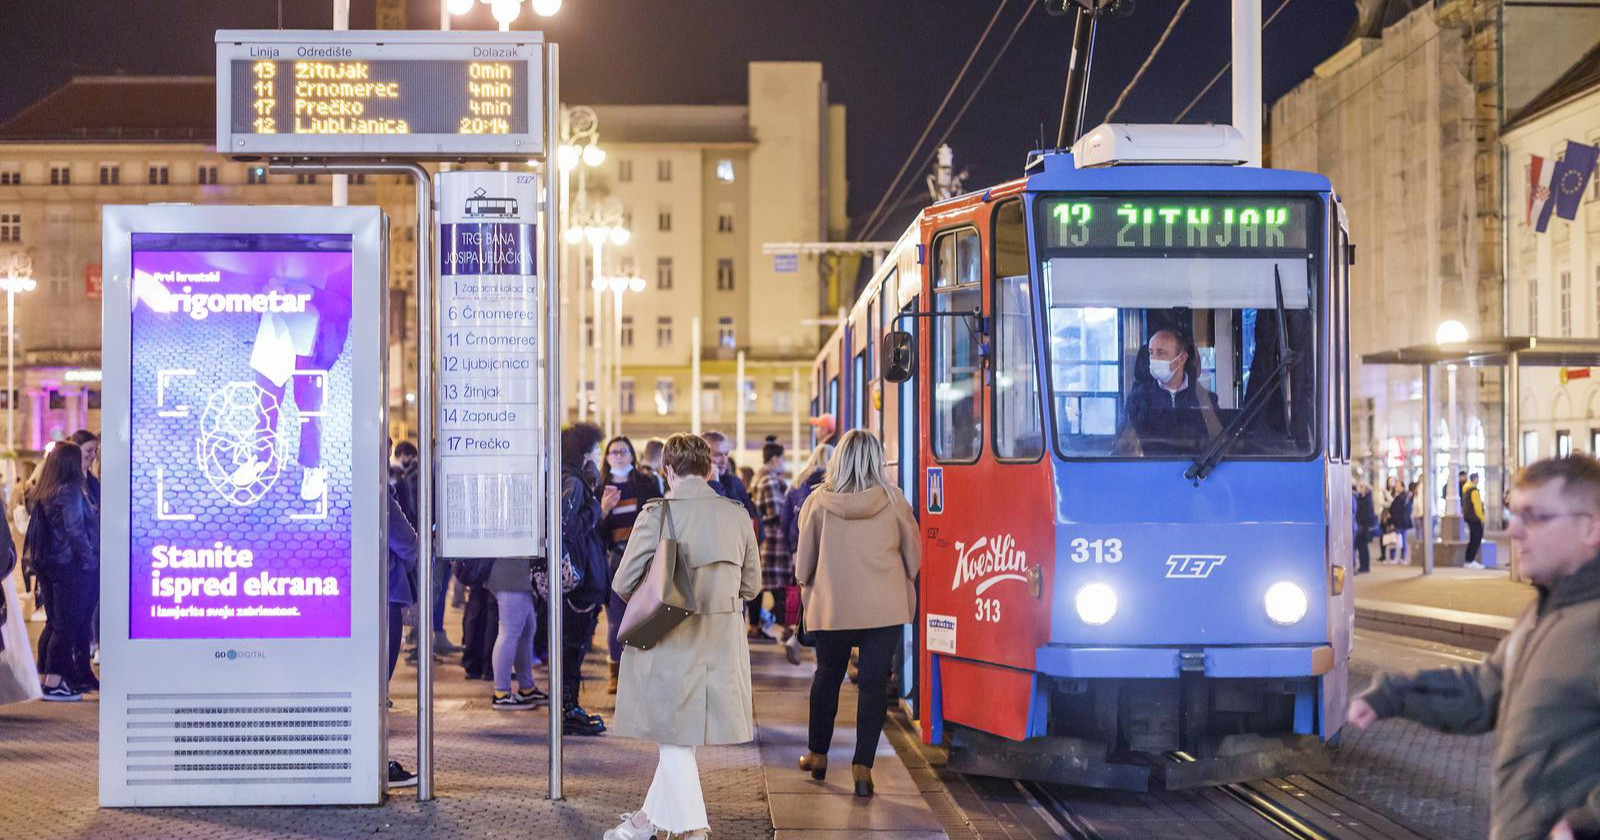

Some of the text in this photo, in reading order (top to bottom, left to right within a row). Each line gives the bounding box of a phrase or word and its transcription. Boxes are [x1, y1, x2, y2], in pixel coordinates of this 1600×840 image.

[250, 46, 519, 59] Linija Odredište Dolazak
[253, 61, 512, 79] 13 Žitnjak 0min
[253, 80, 274, 97] 11
[469, 80, 512, 98] 4min
[253, 98, 512, 116] 17 Prečko 4min
[253, 117, 509, 134] 12 Ljubljanica 20:14
[1053, 202, 1287, 247] 13 ŽITNJAK
[461, 232, 515, 245] TRG BANA
[444, 251, 480, 265] JOSIPA
[454, 281, 458, 296] 1
[155, 286, 311, 320] rigometar
[448, 304, 534, 320] 6 Črnomerec
[447, 331, 535, 347] 11 Črnomerec
[443, 356, 458, 372] 12
[444, 383, 502, 400] 13 Žitnjak
[443, 408, 458, 423] 14
[447, 436, 511, 451] 17 Prečko
[152, 541, 254, 569] Stanite
[1071, 538, 1123, 563] 313
[952, 533, 1029, 591] Koestlin
[1165, 554, 1227, 578] ZET
[152, 570, 340, 603] ispred ekrana
[975, 597, 1001, 623] 313
[214, 651, 226, 659] GO
